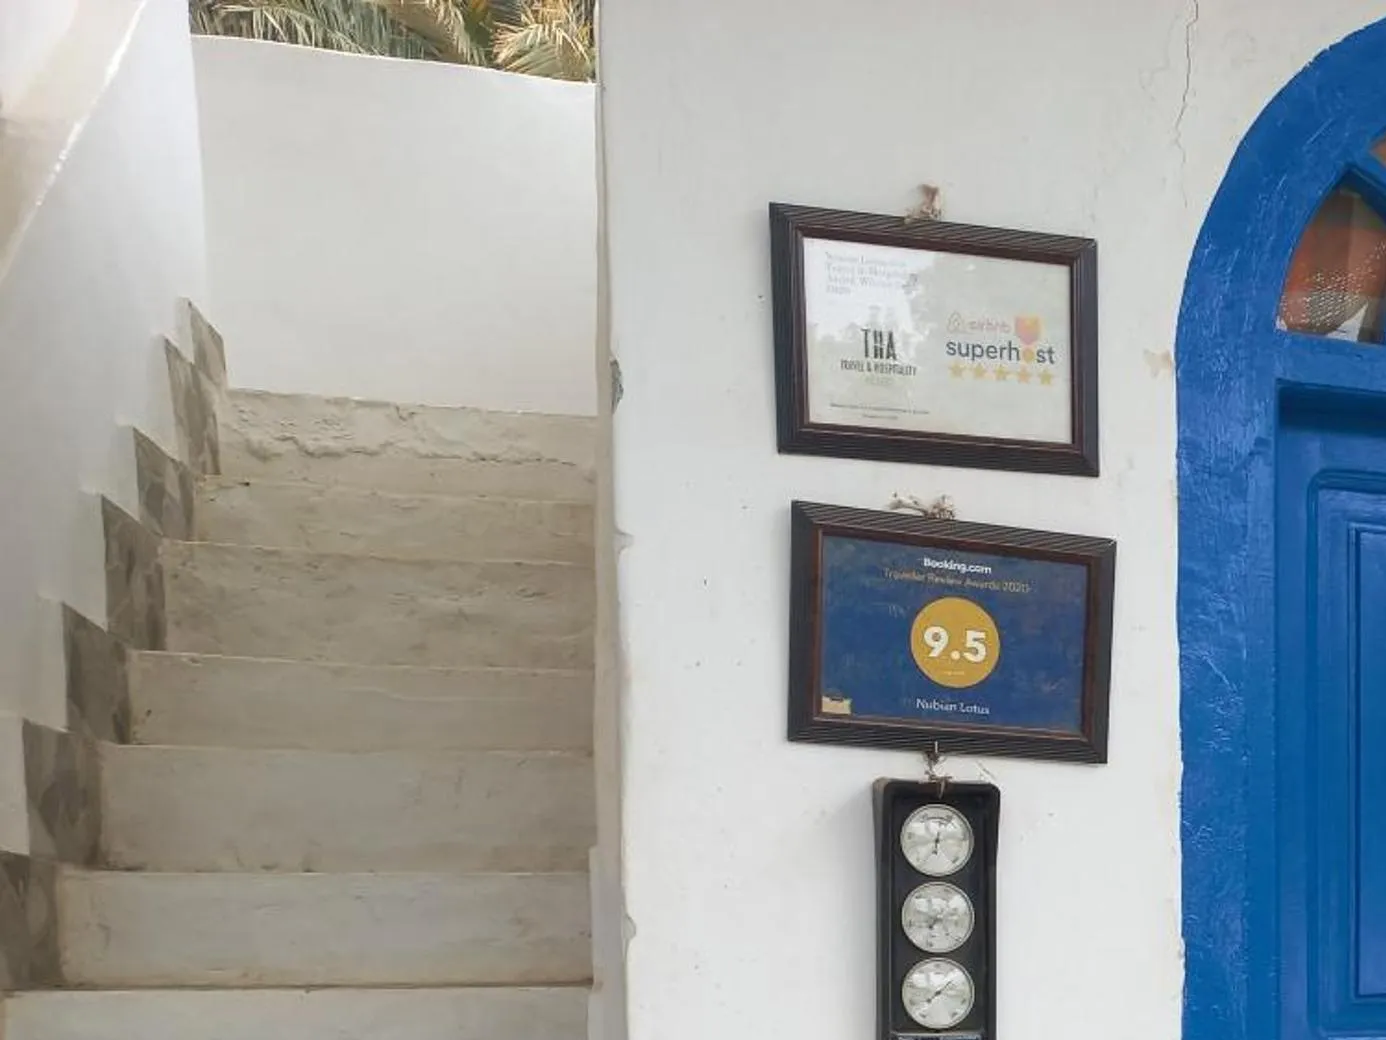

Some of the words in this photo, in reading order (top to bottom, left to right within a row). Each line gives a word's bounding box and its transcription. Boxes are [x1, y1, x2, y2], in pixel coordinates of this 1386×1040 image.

[945, 340, 1056, 365] superhost
[923, 557, 992, 575] Booking.com
[923, 625, 987, 663] 9.5
[916, 698, 957, 712] Nubian
[958, 702, 991, 715] Lotus
